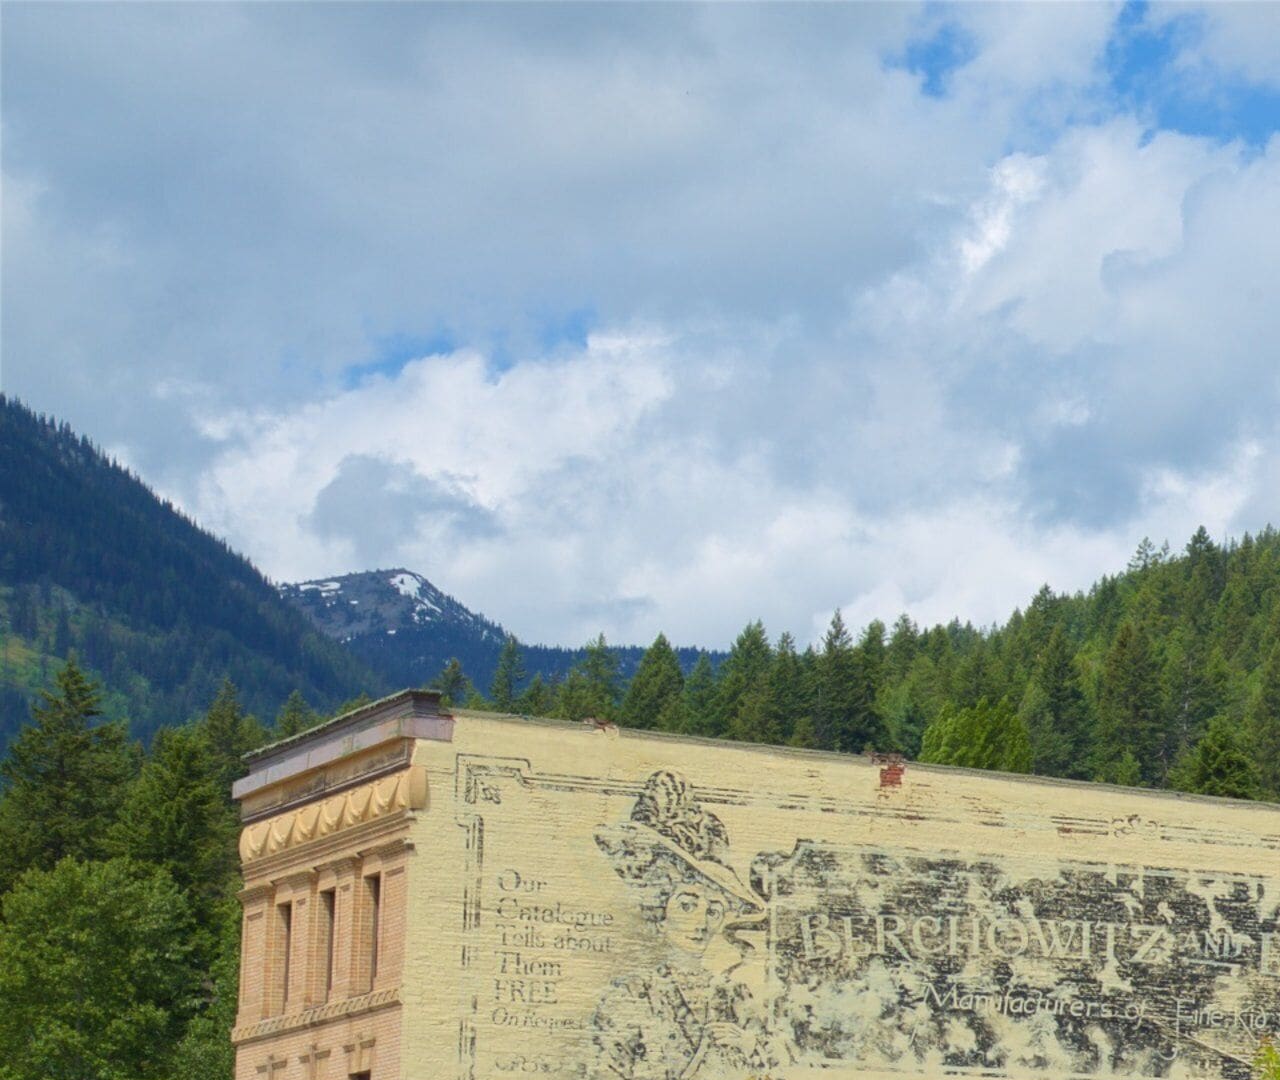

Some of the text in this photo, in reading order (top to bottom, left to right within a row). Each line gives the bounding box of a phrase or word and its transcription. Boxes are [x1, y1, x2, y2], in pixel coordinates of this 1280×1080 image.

[497, 867, 549, 893] Our
[496, 896, 615, 933] Catalogue
[553, 928, 615, 953] about
[494, 950, 562, 976] Them
[494, 978, 558, 1005] FREE
[491, 1007, 518, 1026] On
